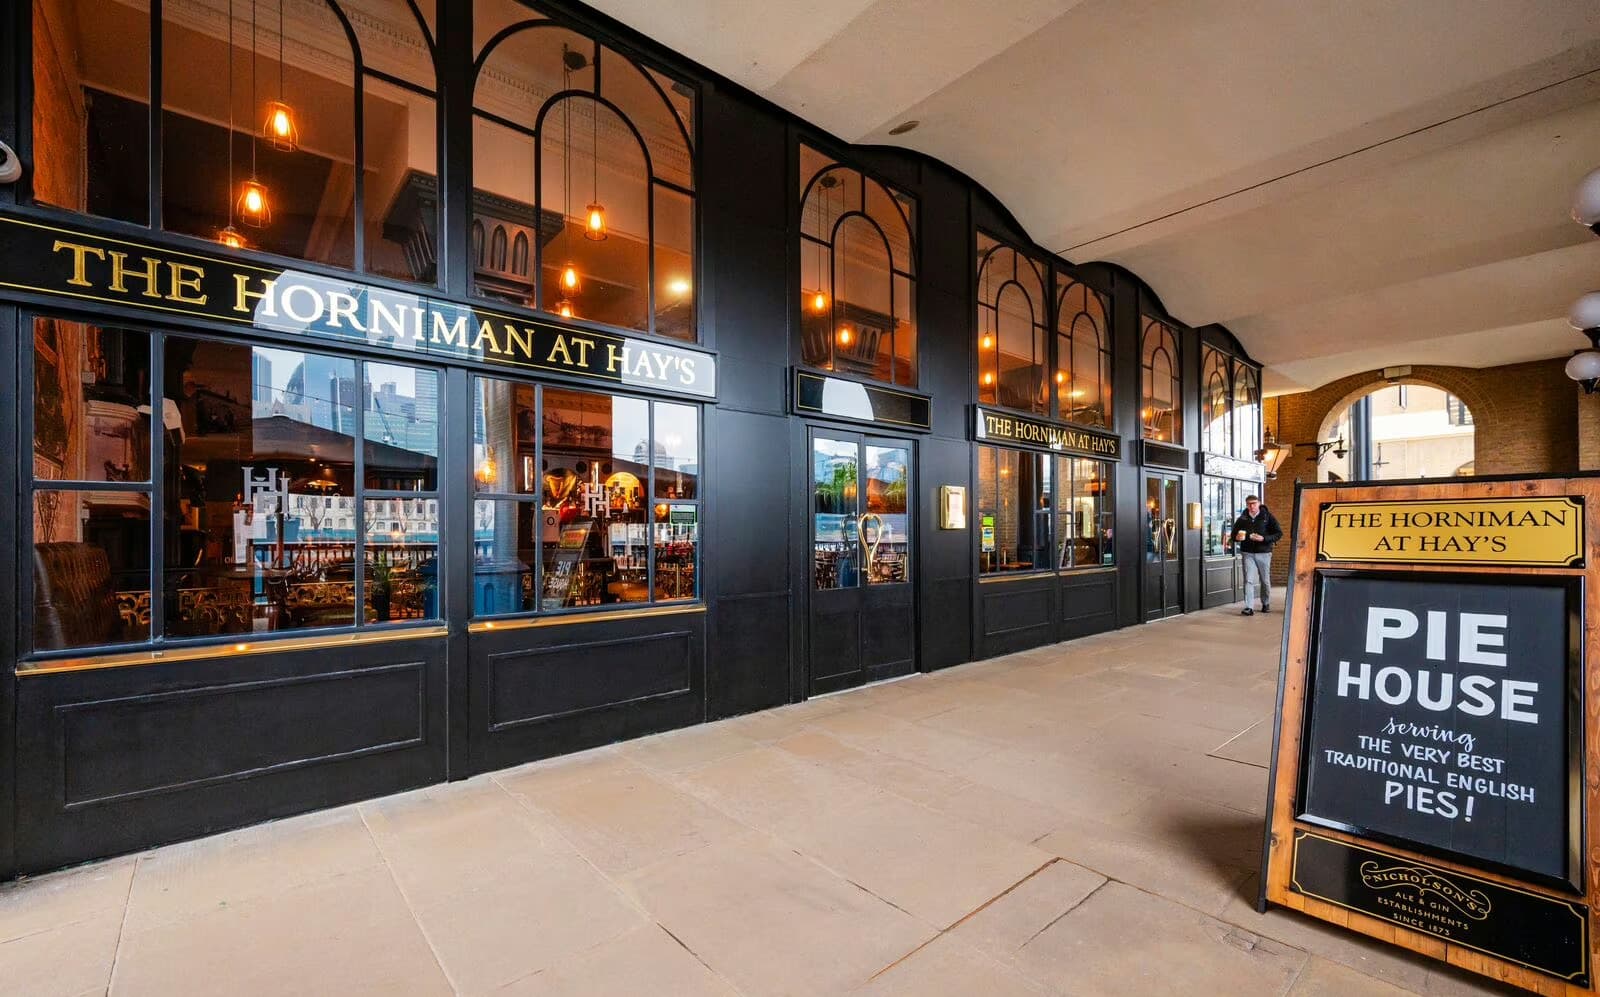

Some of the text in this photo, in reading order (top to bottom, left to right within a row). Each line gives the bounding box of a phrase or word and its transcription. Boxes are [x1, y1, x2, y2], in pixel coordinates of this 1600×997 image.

[53, 239, 697, 386] THE HORNIMAN AT HAY'S
[986, 415, 1116, 454] THE HORNIMAN AT HAY'S
[1331, 509, 1568, 528] THE HORNIMAN
[1373, 535, 1507, 553] AT HAY'S
[1365, 606, 1508, 668] PIE
[1337, 660, 1539, 724] HOUSE
[1381, 717, 1476, 753] serving
[1358, 735, 1505, 775] THE VERY BEST
[1325, 749, 1535, 804] TRADITIONAL ENGLISH
[1384, 780, 1474, 823] PIES!
[1372, 872, 1478, 912] NICHOLSON'S
[1394, 891, 1450, 913] ALE & GIN
[1377, 896, 1470, 931] ESTABLISHMENTS
[1393, 913, 1451, 937] SINCE 1873
